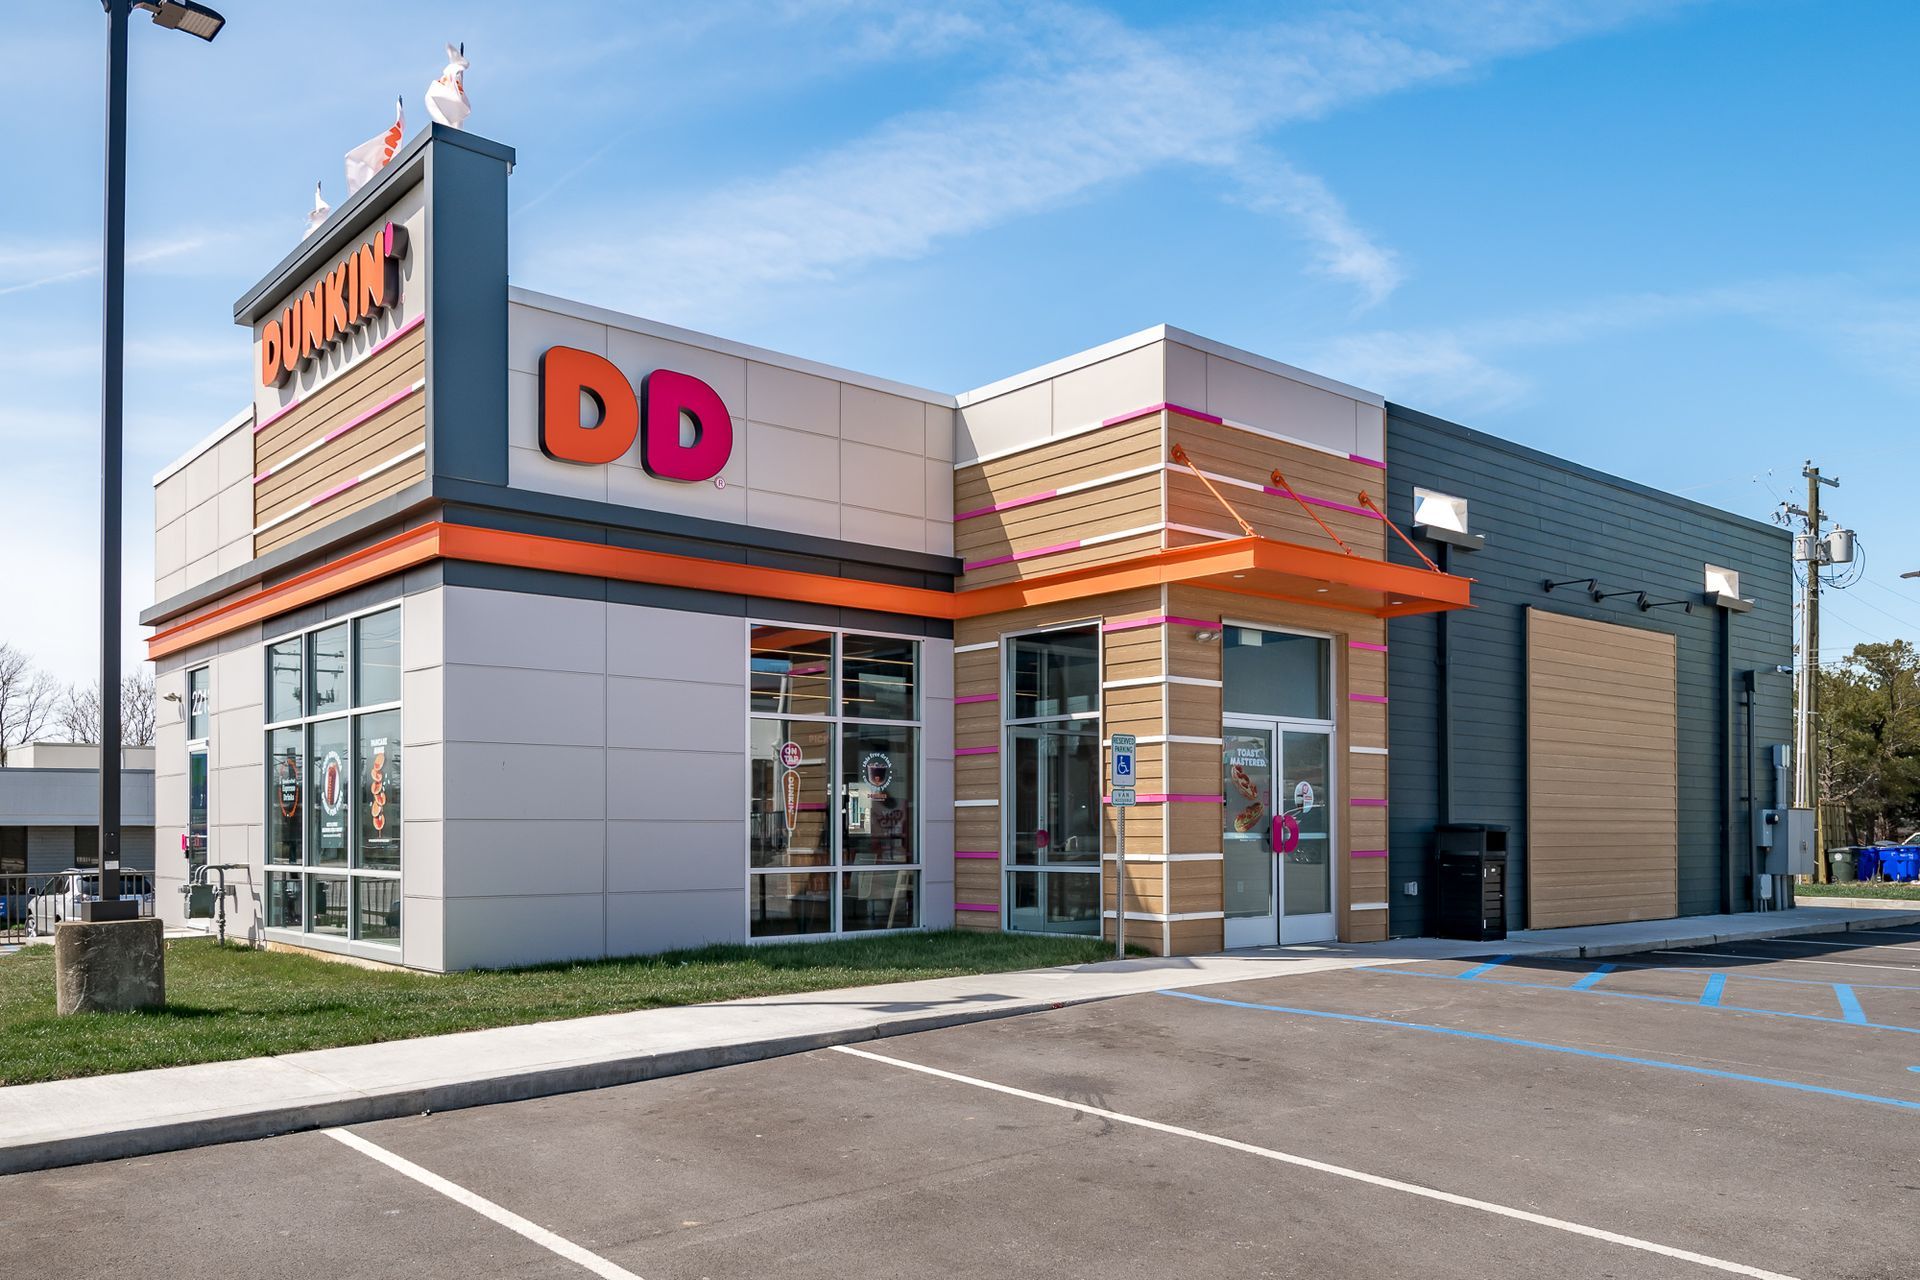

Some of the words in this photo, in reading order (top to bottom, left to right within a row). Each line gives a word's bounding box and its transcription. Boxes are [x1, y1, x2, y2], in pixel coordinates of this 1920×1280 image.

[262, 221, 398, 387] DUNKIN'
[1113, 736, 1135, 745] RESERVED
[784, 747, 797, 755] ON
[1115, 745, 1133, 753] PARKING
[1237, 748, 1260, 757] TOAST.
[784, 755, 799, 763] TAP
[1230, 757, 1267, 767] MASTERED.
